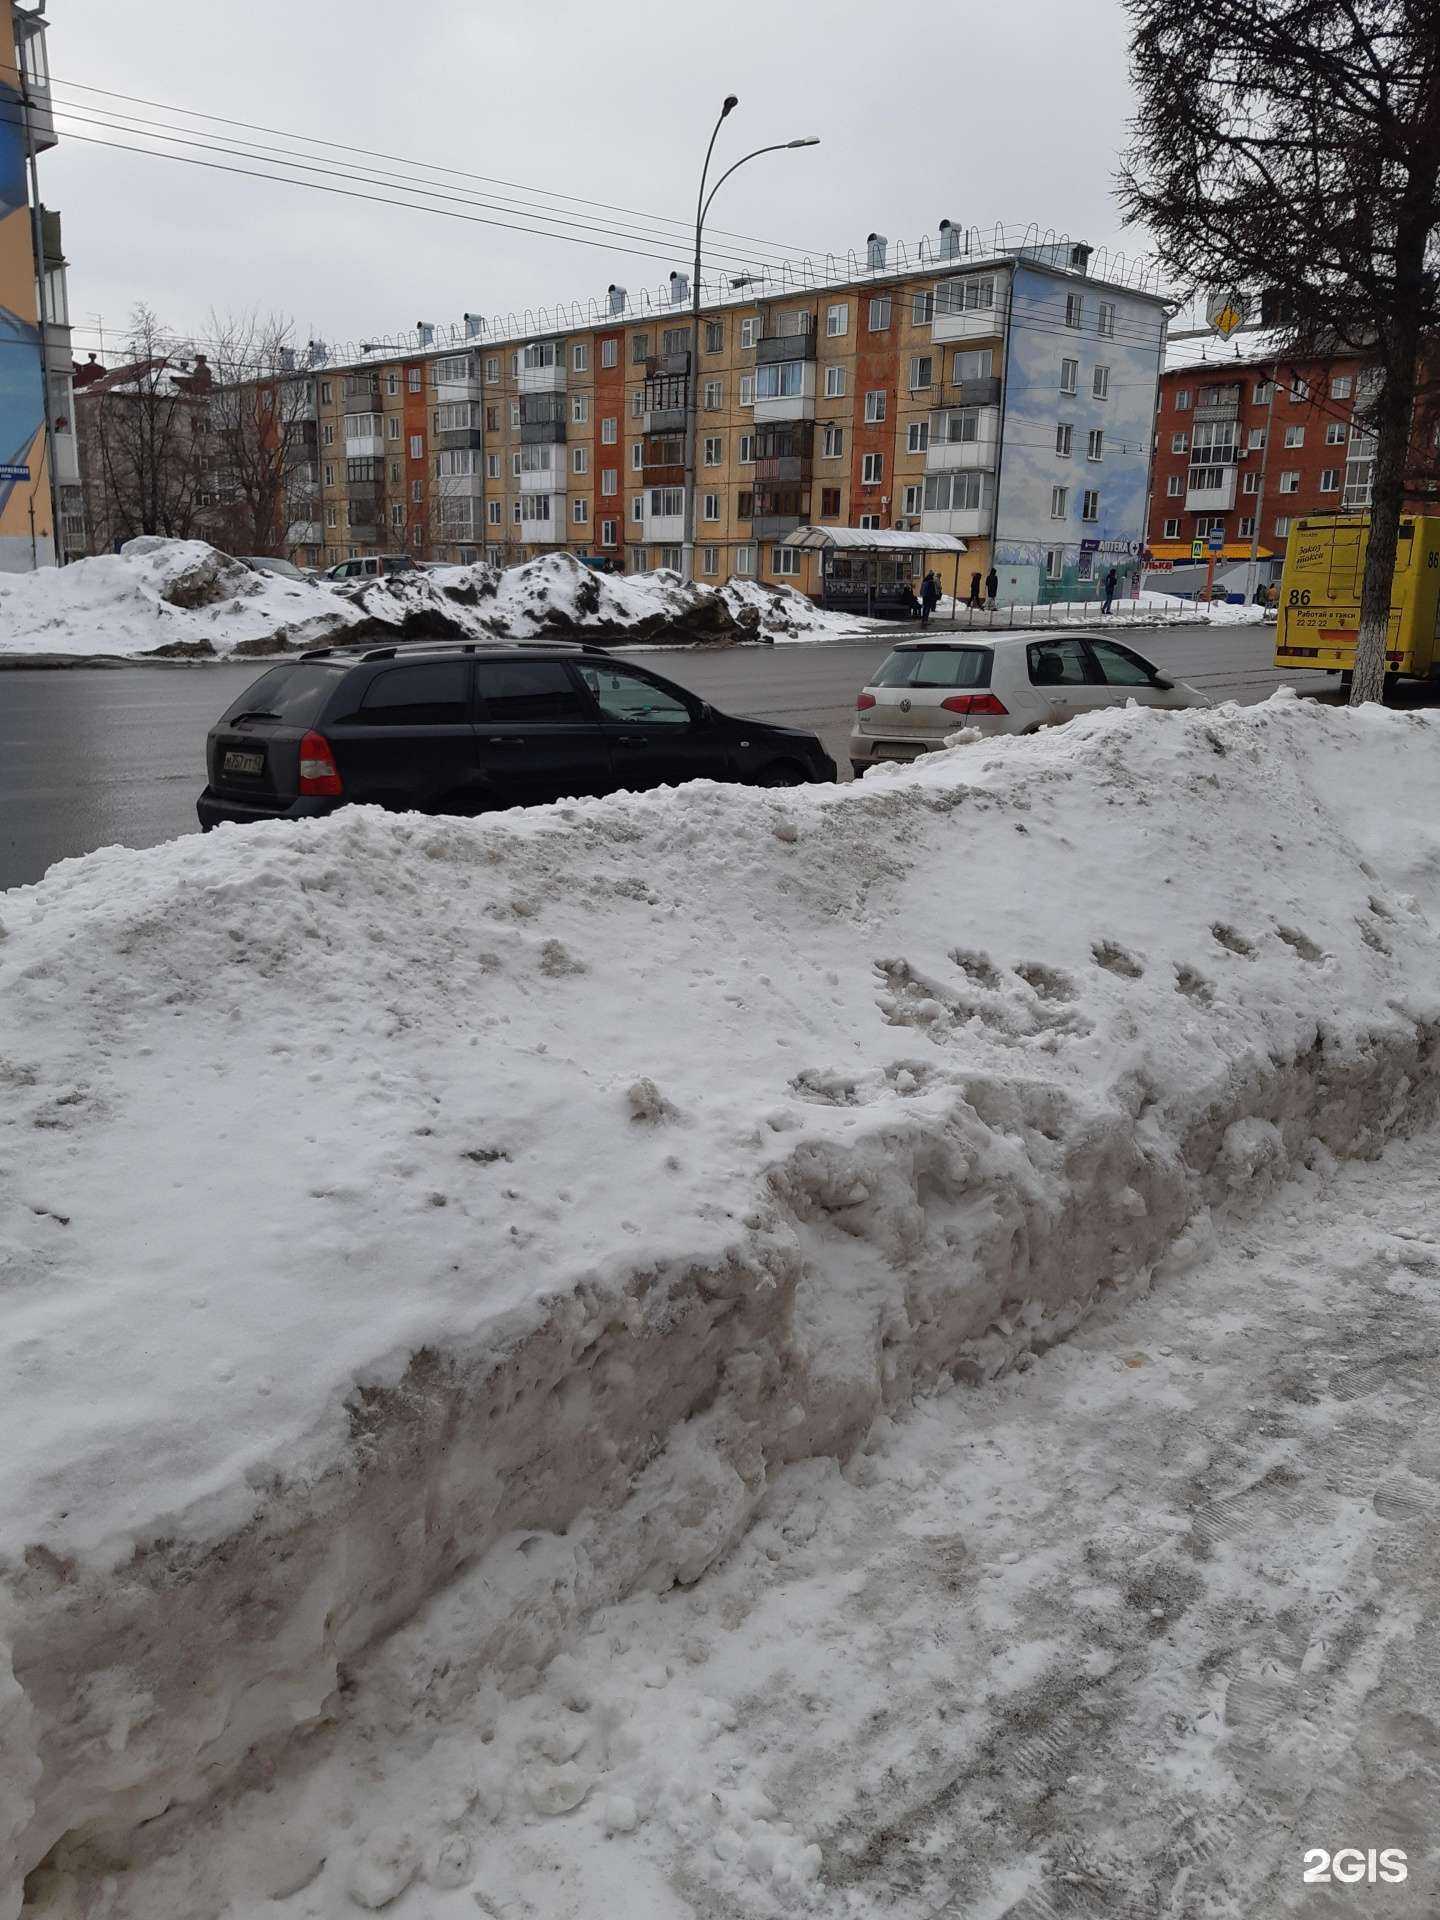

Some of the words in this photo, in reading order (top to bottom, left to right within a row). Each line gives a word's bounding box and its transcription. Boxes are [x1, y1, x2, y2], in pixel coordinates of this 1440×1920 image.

[1098, 541, 1128, 553] АПТЕКА
[1428, 552, 1439, 569] 86
[1289, 589, 1312, 606] 86
[1297, 609, 1328, 618] Работай
